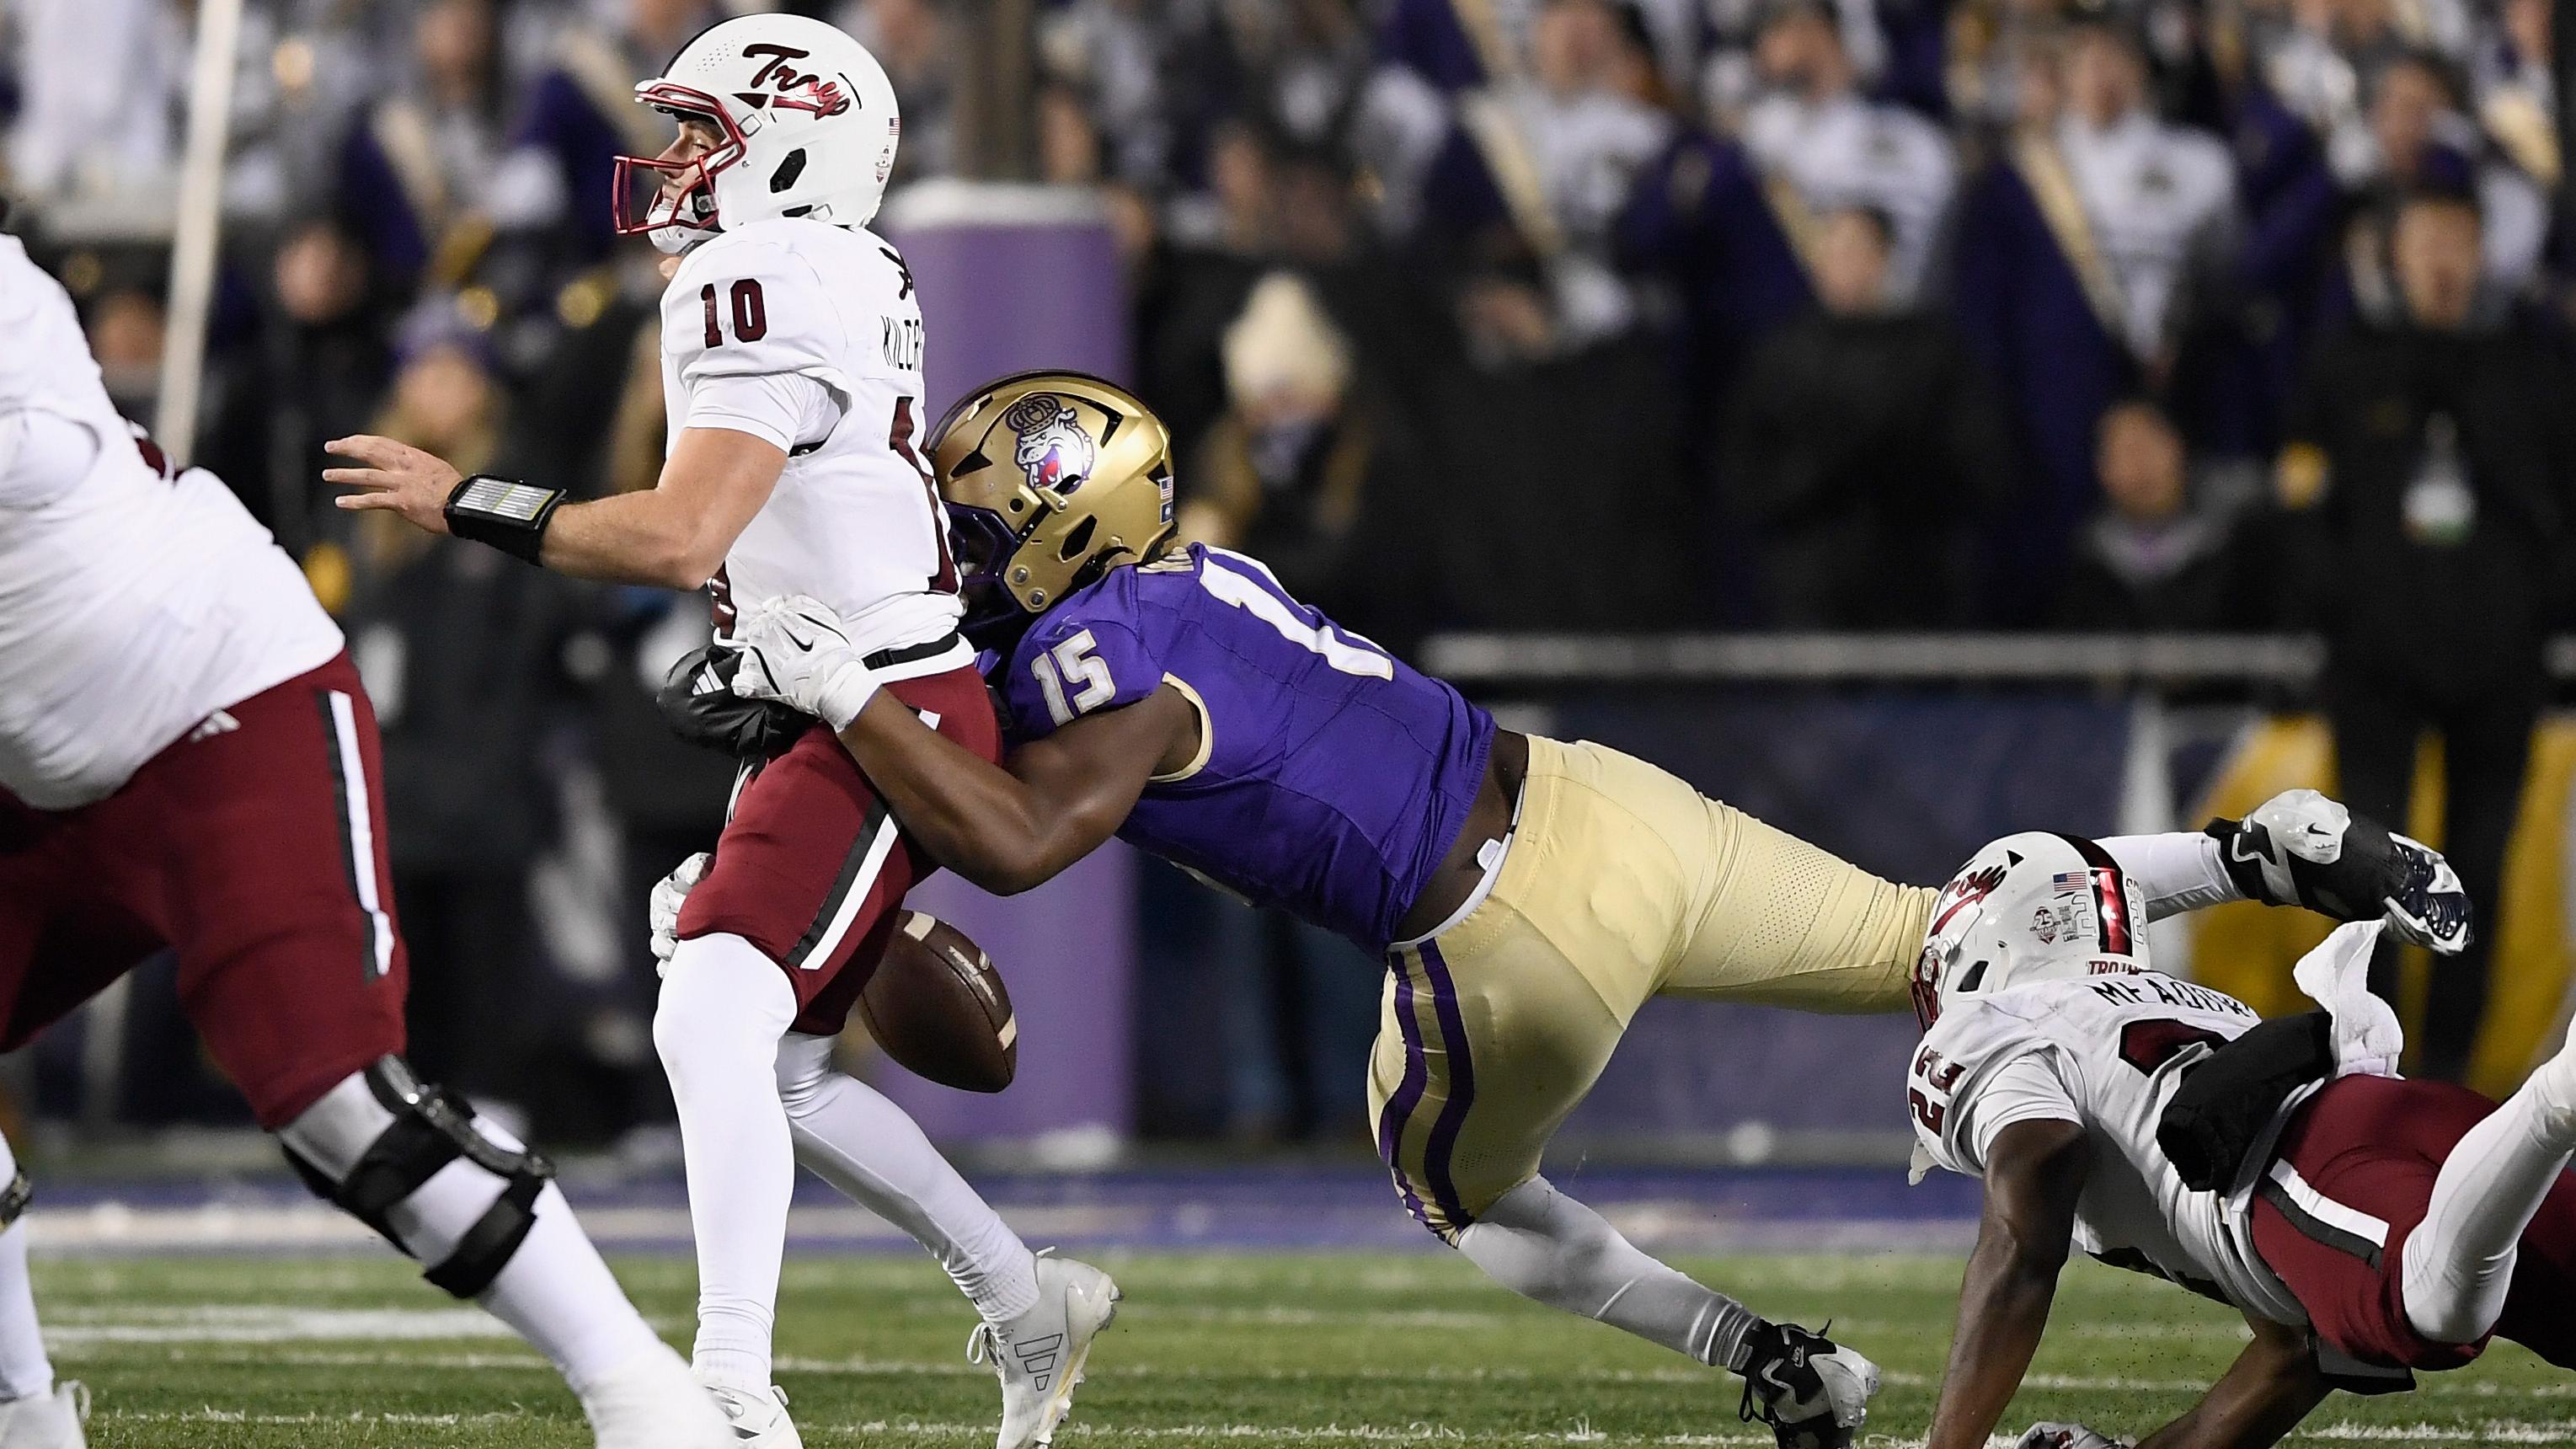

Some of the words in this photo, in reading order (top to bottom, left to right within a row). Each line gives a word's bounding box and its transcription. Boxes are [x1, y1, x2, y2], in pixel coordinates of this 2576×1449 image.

[731, 43, 852, 121] Troy
[699, 277, 767, 350] 10
[879, 314, 922, 372] KILCR
[1030, 628, 1117, 728] 15
[2084, 978, 2252, 1018] MEADOW
[1908, 1045, 1967, 1138] 22
